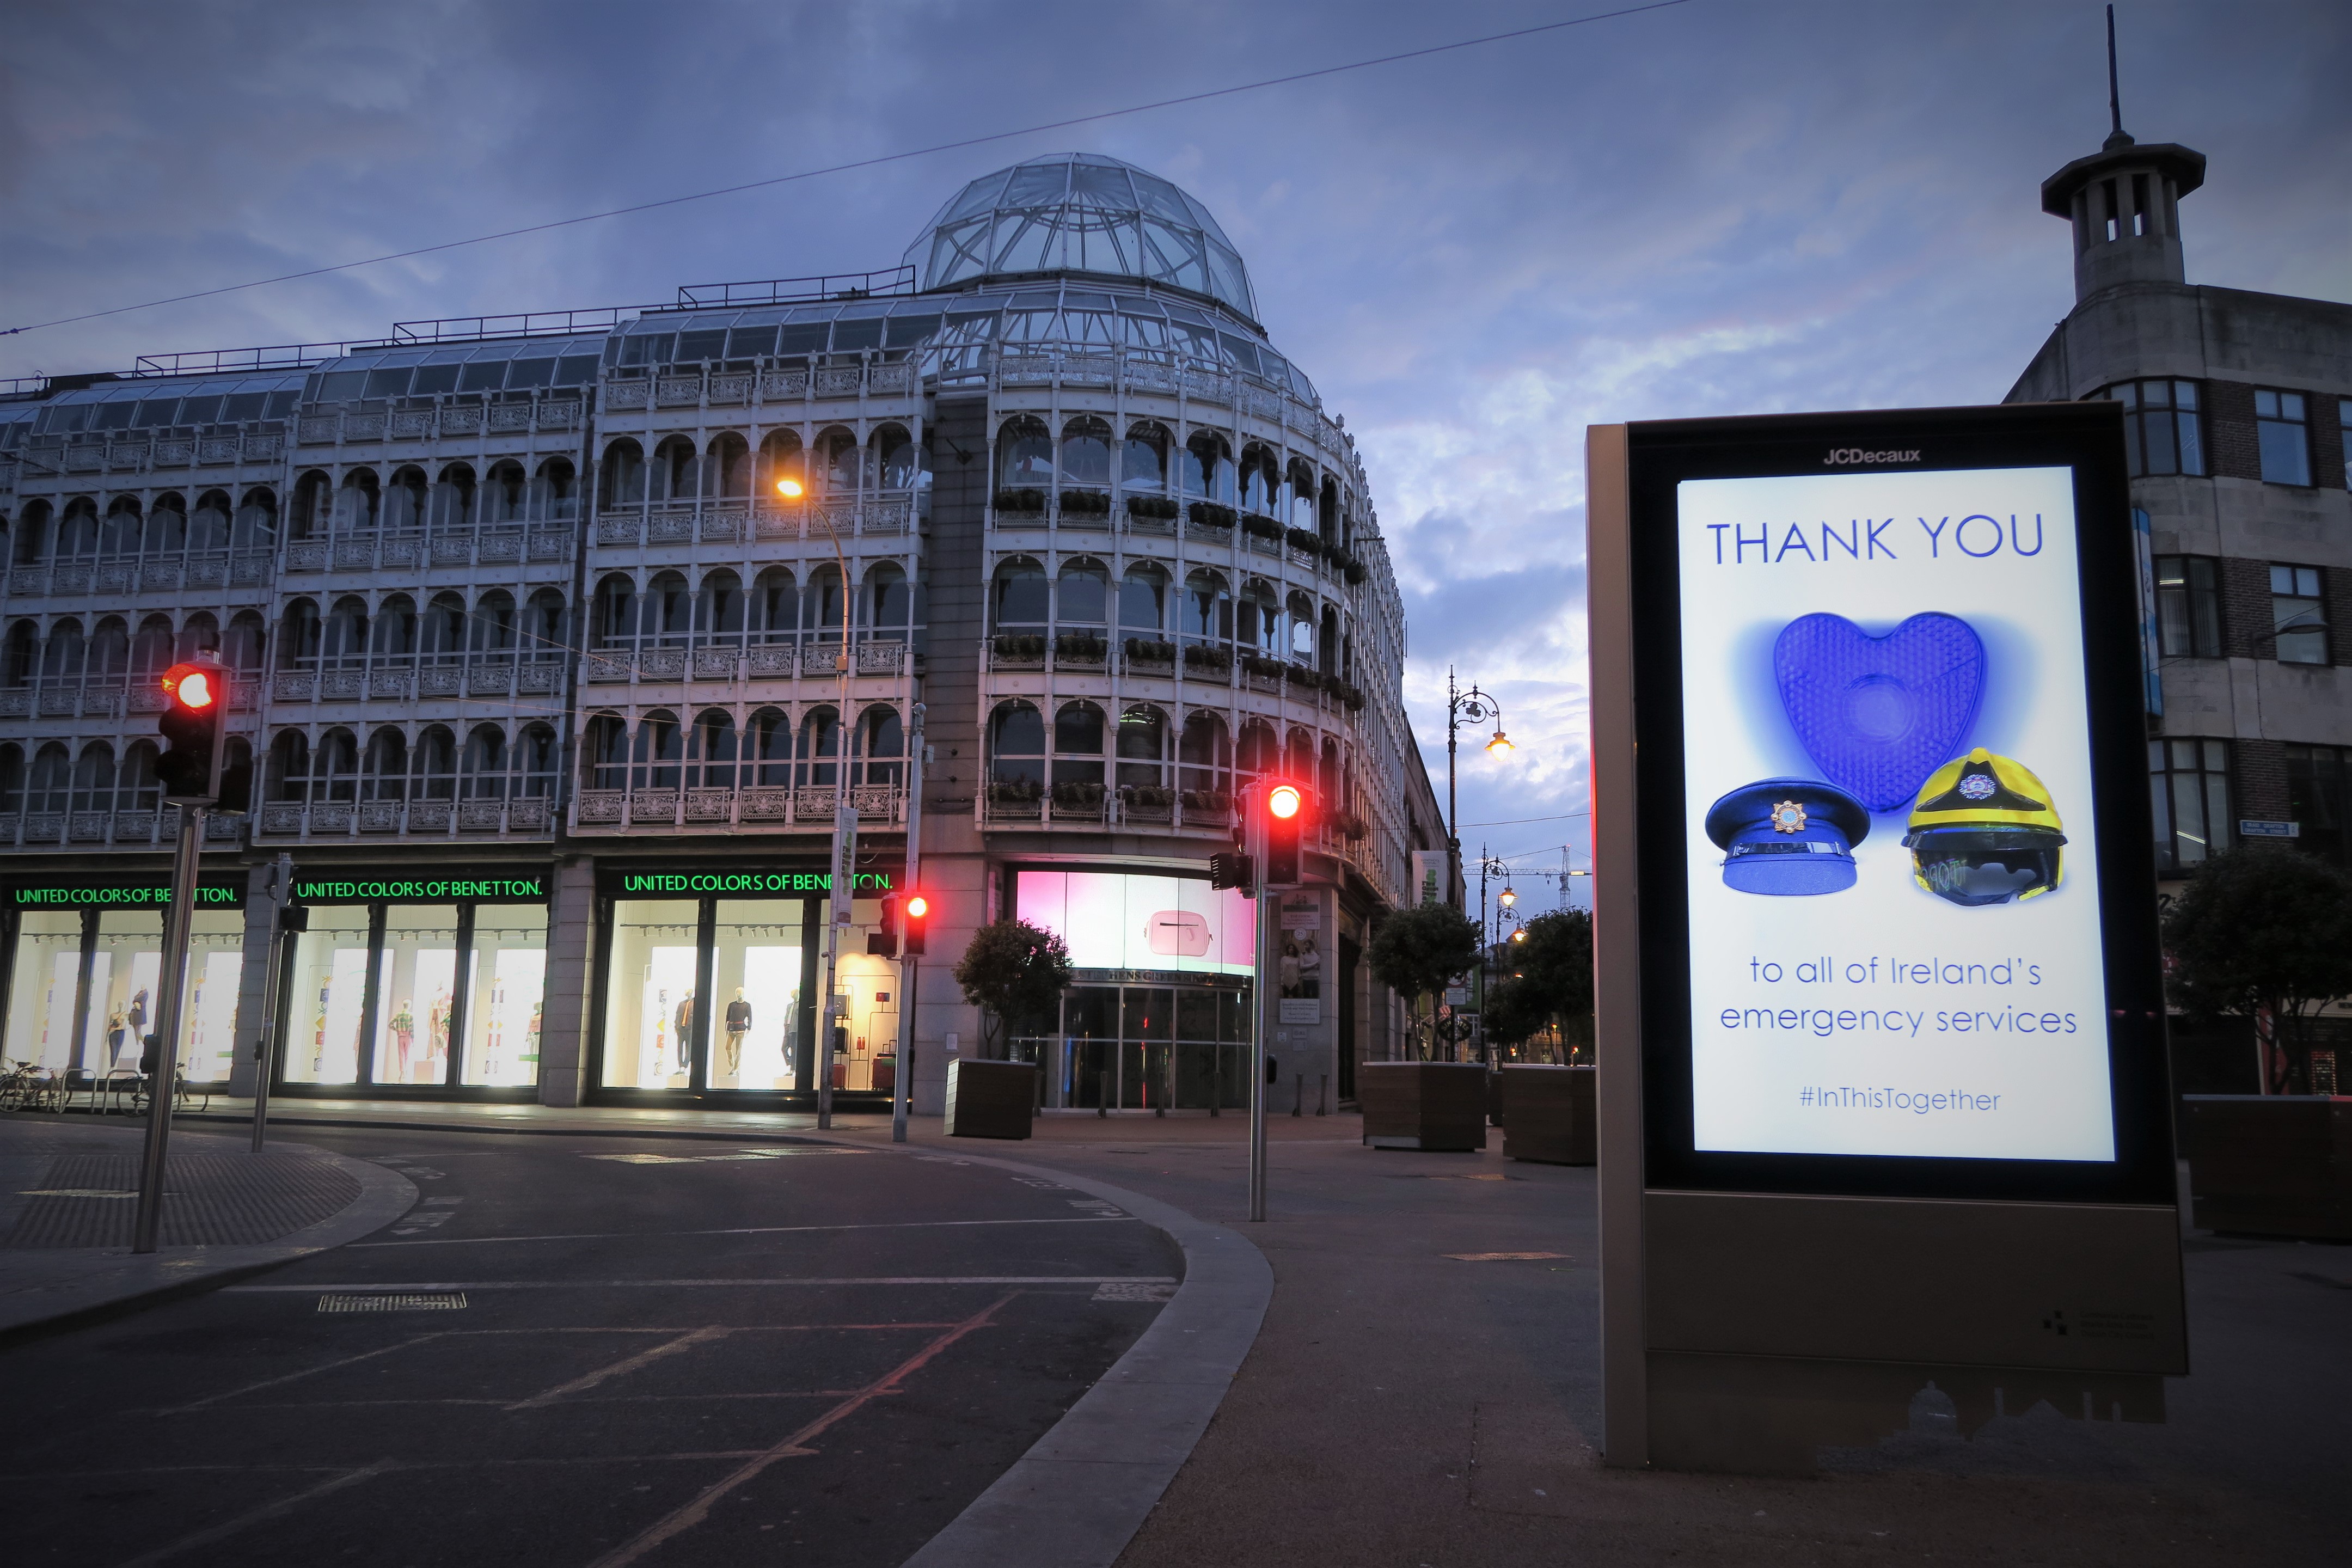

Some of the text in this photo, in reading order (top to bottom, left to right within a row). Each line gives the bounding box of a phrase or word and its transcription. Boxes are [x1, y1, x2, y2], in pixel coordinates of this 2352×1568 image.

[1824, 449, 1920, 464] JCDecaux
[1706, 513, 2045, 565] THANK YOU
[297, 881, 543, 897] UNITED COLORS OF BENETTON.
[625, 874, 893, 891] UNITED COLORS OF BENETON.
[16, 888, 237, 903] UNITED COLORS OF BETTON.
[1143, 971, 1181, 983] GREEN
[1750, 955, 2042, 985] to all of Ireland's
[1720, 1004, 2078, 1038] emergency services
[1799, 1086, 2002, 1114] #InThisTogether
